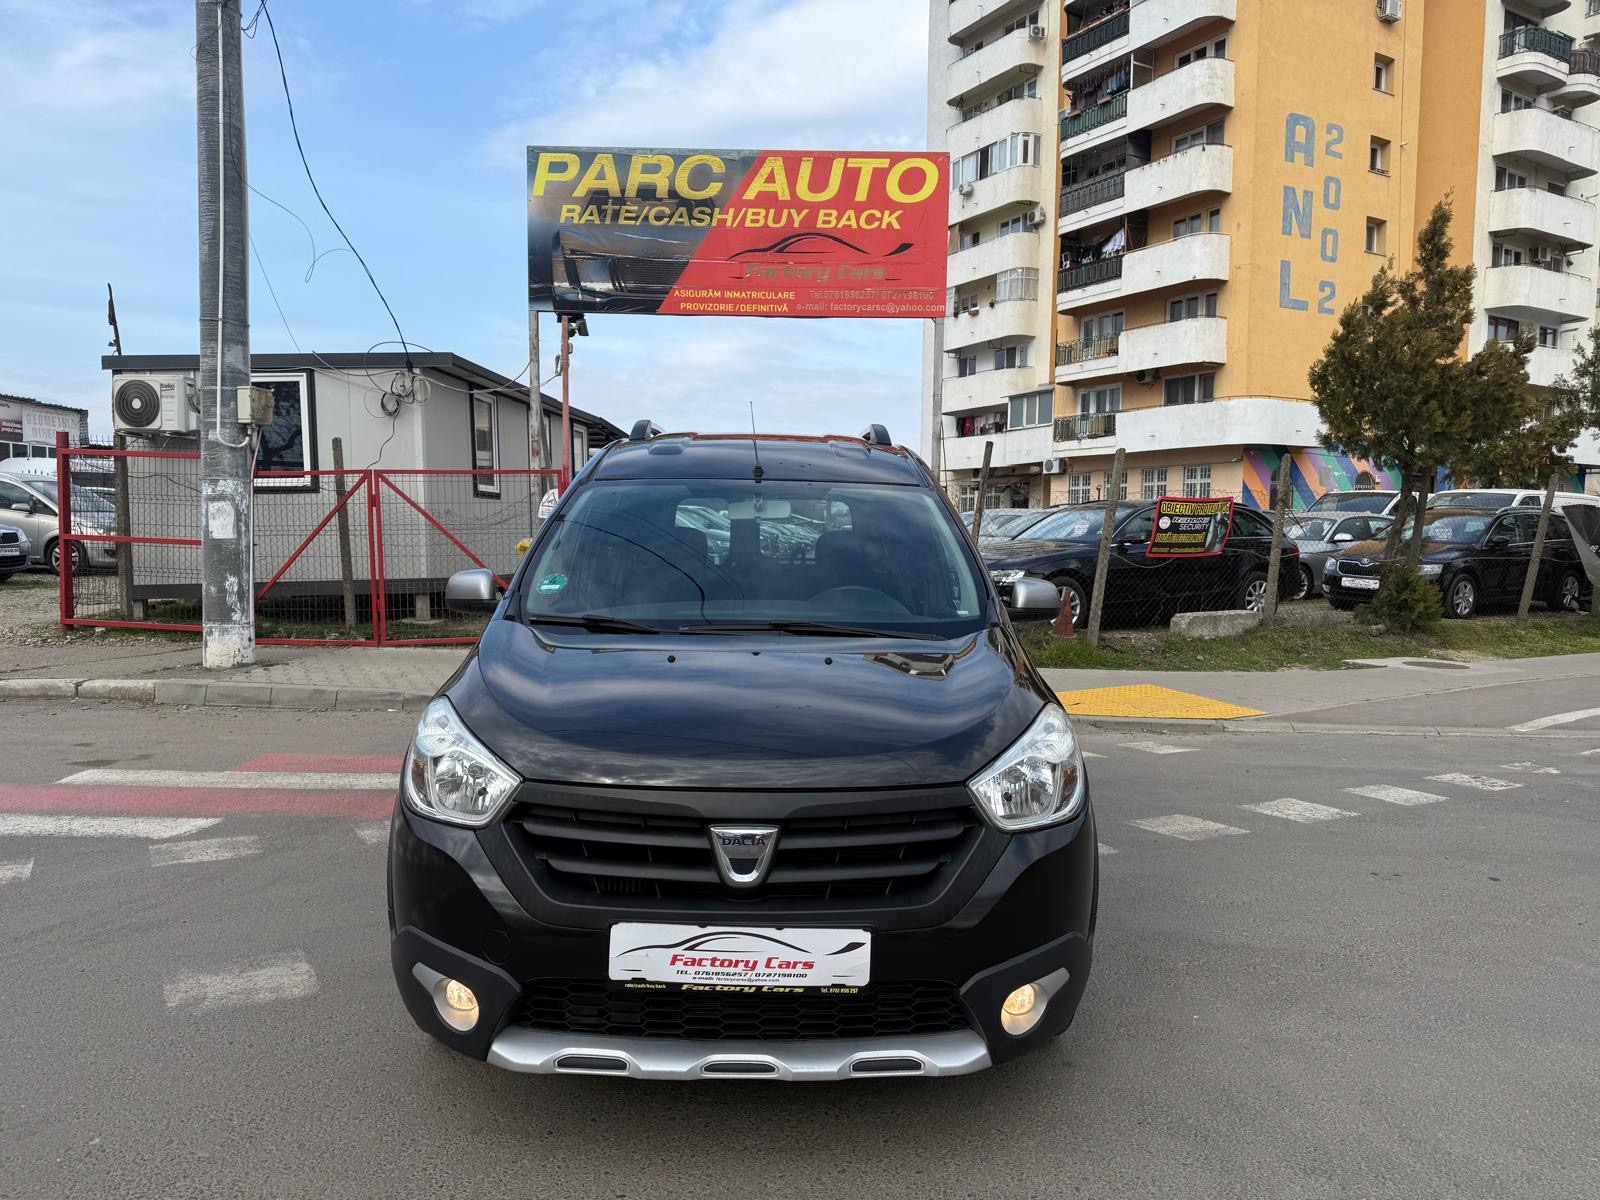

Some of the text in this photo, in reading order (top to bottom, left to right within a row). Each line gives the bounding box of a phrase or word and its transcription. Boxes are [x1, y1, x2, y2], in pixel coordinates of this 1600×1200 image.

[532, 152, 939, 204] PARC AUTO
[559, 204, 904, 230] RATE/CASH/BUY BACK
[746, 263, 886, 282] Factory Cars
[674, 289, 796, 300] ASIGURĂM INMATRICULARE
[796, 302, 945, 313] e-mail: factorycarsc@yahoo.com
[1161, 501, 1194, 515] OBIECTIV
[1179, 523, 1209, 531] SECURITY
[722, 837, 766, 846] DACIA
[669, 954, 816, 972] Factory Cars
[694, 970, 749, 978] 0761856257
[680, 983, 805, 993] Factory Cars
